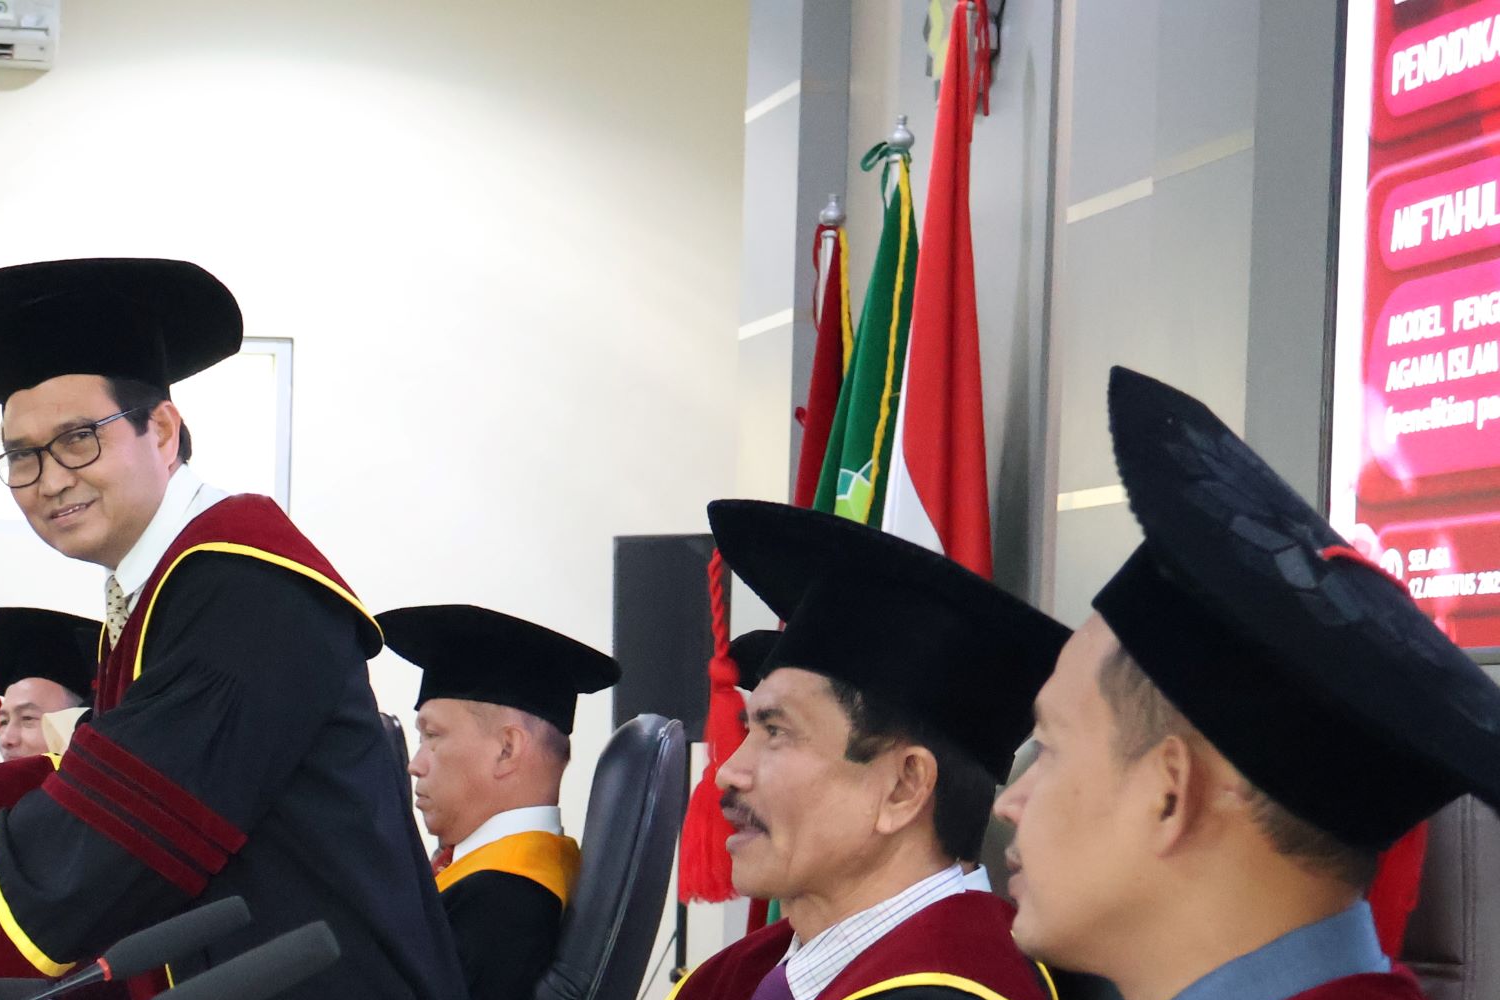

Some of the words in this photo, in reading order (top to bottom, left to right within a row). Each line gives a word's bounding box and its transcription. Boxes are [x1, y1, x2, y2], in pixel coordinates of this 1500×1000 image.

[1390, 180, 1500, 253] MIFTAHUL
[1387, 305, 1445, 347] MODEL
[1385, 352, 1445, 392] AGAMA
[1447, 340, 1498, 380] ISLAM
